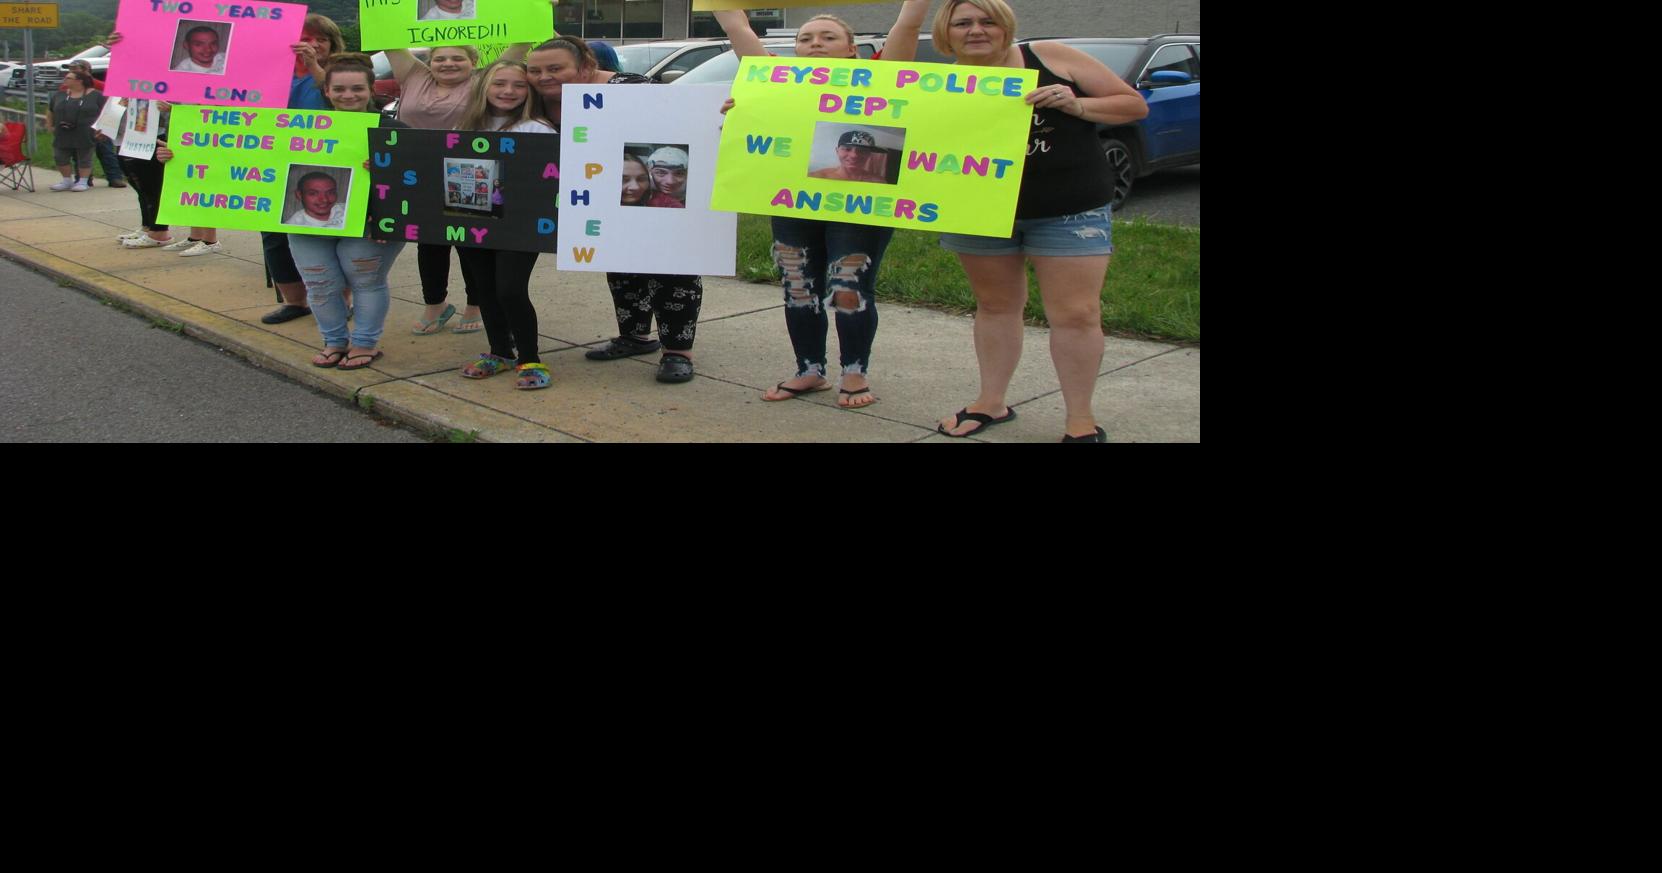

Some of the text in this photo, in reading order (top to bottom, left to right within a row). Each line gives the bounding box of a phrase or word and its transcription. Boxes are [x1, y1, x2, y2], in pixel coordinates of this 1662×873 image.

[3, 16, 52, 24] THE ROAD
[11, 6, 41, 14] SHARE
[151, 0, 283, 20] TWO YEARS
[128, 79, 261, 103] TOO LONG
[746, 65, 1023, 97] KEYSER POLICE
[818, 93, 909, 119] DEPT
[200, 109, 332, 129] THEY SAID
[181, 132, 339, 153] SUICIDE BUT
[446, 133, 515, 153] FOR
[746, 135, 1014, 179] WE WANT
[187, 164, 276, 183] IT WAS
[180, 192, 271, 212] MURDER
[770, 188, 939, 223] ANSWERS
[446, 226, 488, 244] MY
